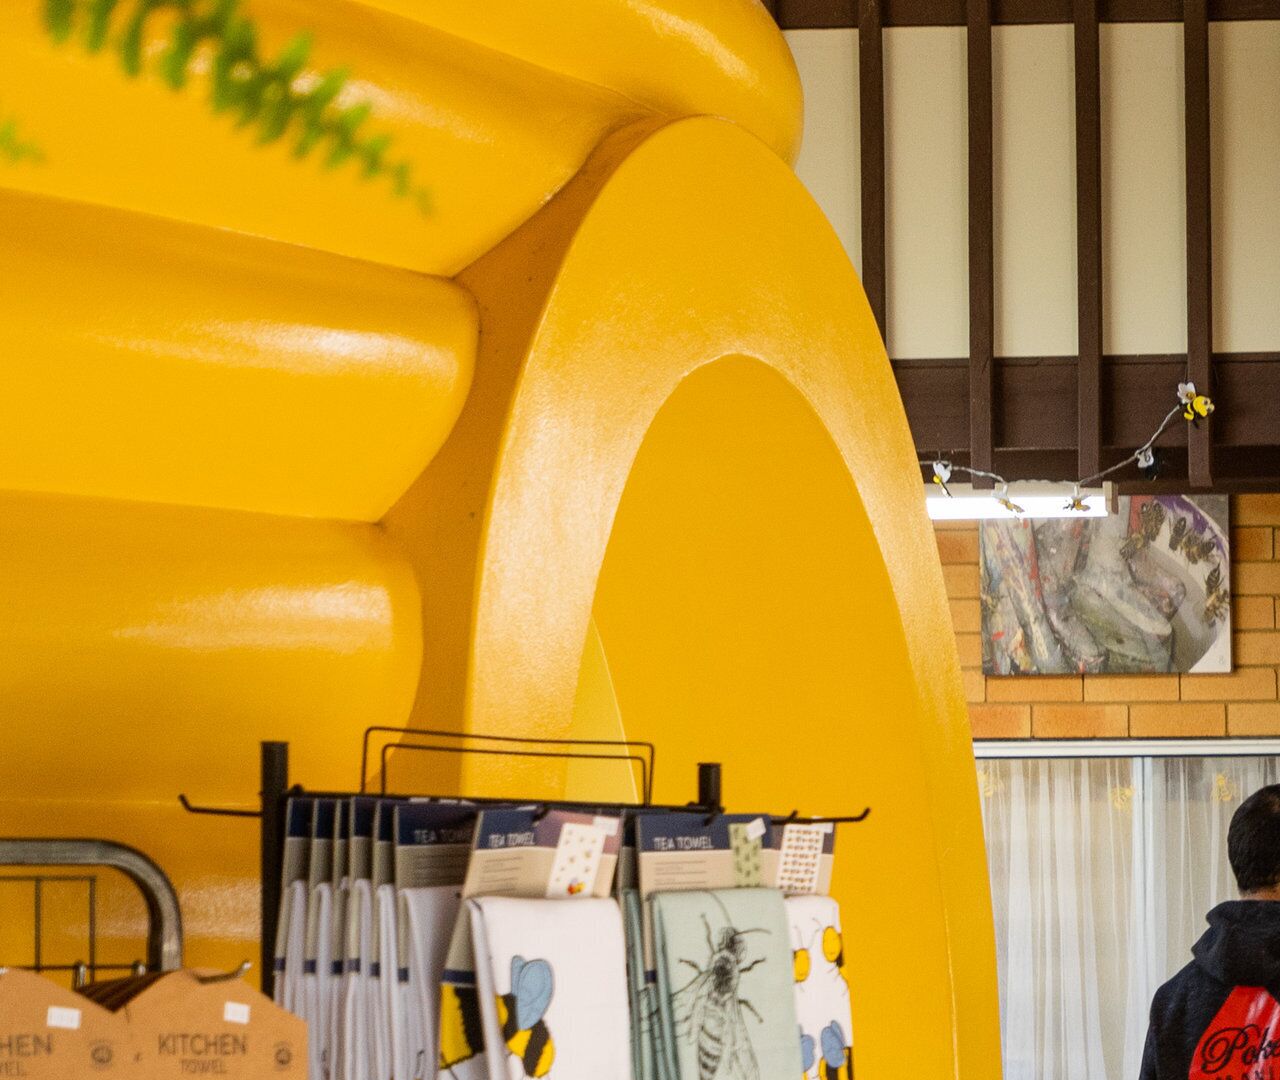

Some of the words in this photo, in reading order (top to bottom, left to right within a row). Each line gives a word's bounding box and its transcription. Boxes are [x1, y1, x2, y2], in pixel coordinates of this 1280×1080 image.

[413, 829, 437, 843] TEA
[440, 829, 473, 842] TOWE
[488, 834, 505, 846] TEA
[653, 837, 675, 850] TEA
[677, 836, 714, 849] TOWEL
[158, 1034, 248, 1056] KITCHEN
[180, 1059, 228, 1075] TOWEL
